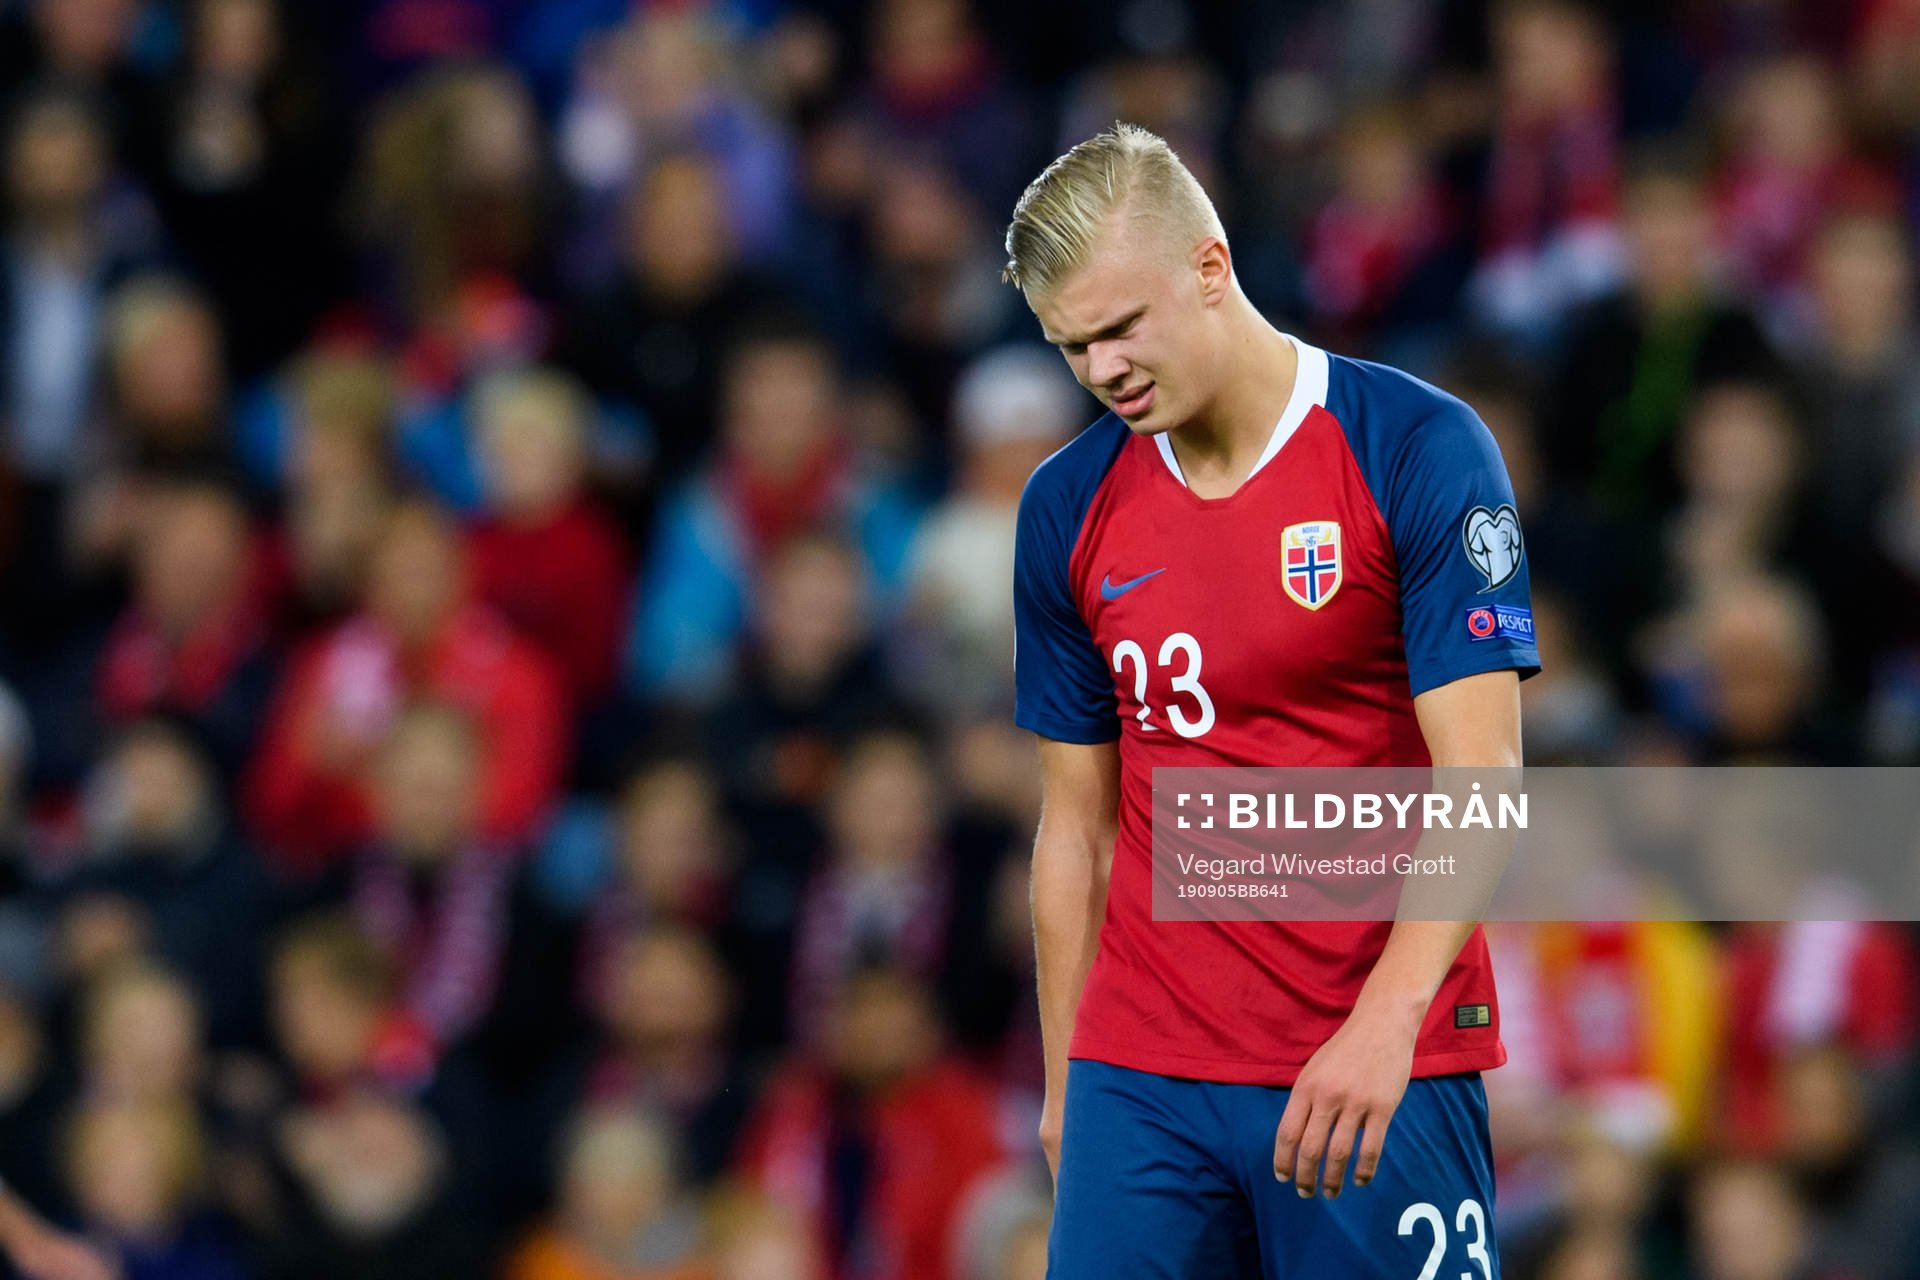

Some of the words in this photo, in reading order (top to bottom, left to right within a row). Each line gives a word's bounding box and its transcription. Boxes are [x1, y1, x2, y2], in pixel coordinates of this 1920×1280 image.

[1497, 613, 1532, 633] RESPECT
[1112, 632, 1216, 738] 23
[1397, 1198, 1493, 1280] 23
